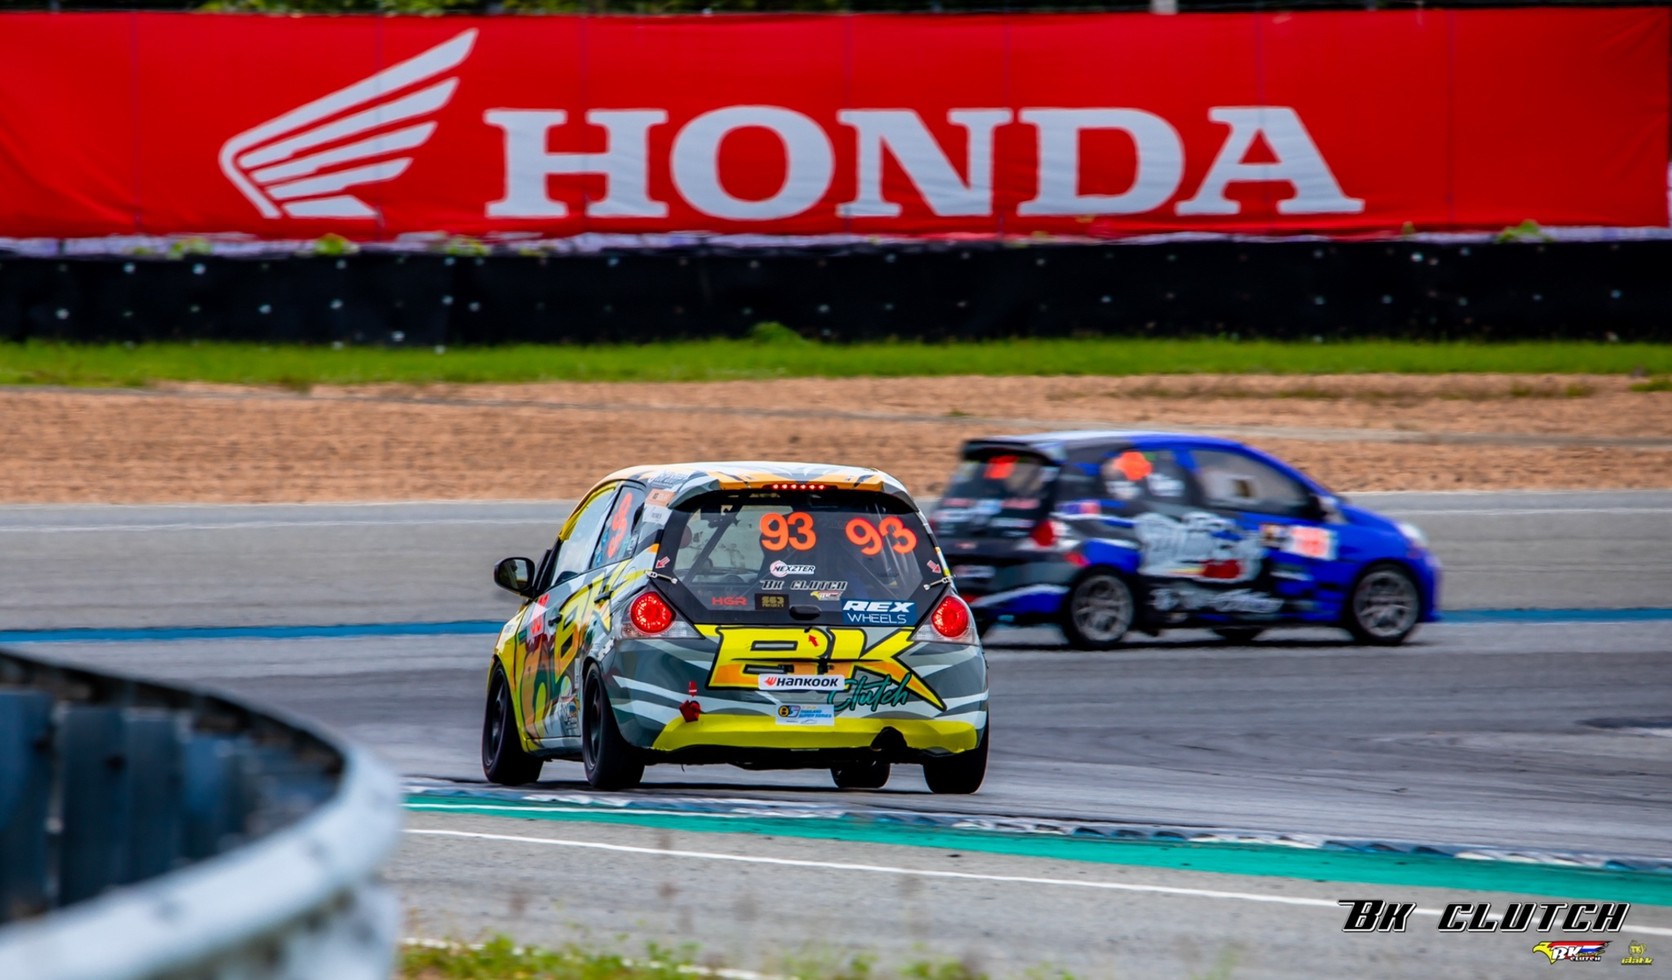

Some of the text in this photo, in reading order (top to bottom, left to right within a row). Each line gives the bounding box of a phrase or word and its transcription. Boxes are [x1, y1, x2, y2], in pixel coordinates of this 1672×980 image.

[483, 105, 1365, 219] HONDA
[759, 511, 817, 551] 93
[846, 515, 918, 556] 93
[790, 580, 848, 590] CLUTCH
[843, 601, 915, 613] REX
[847, 613, 907, 624] WHEELS
[705, 626, 947, 712] BK
[826, 673, 913, 712] Clutch
